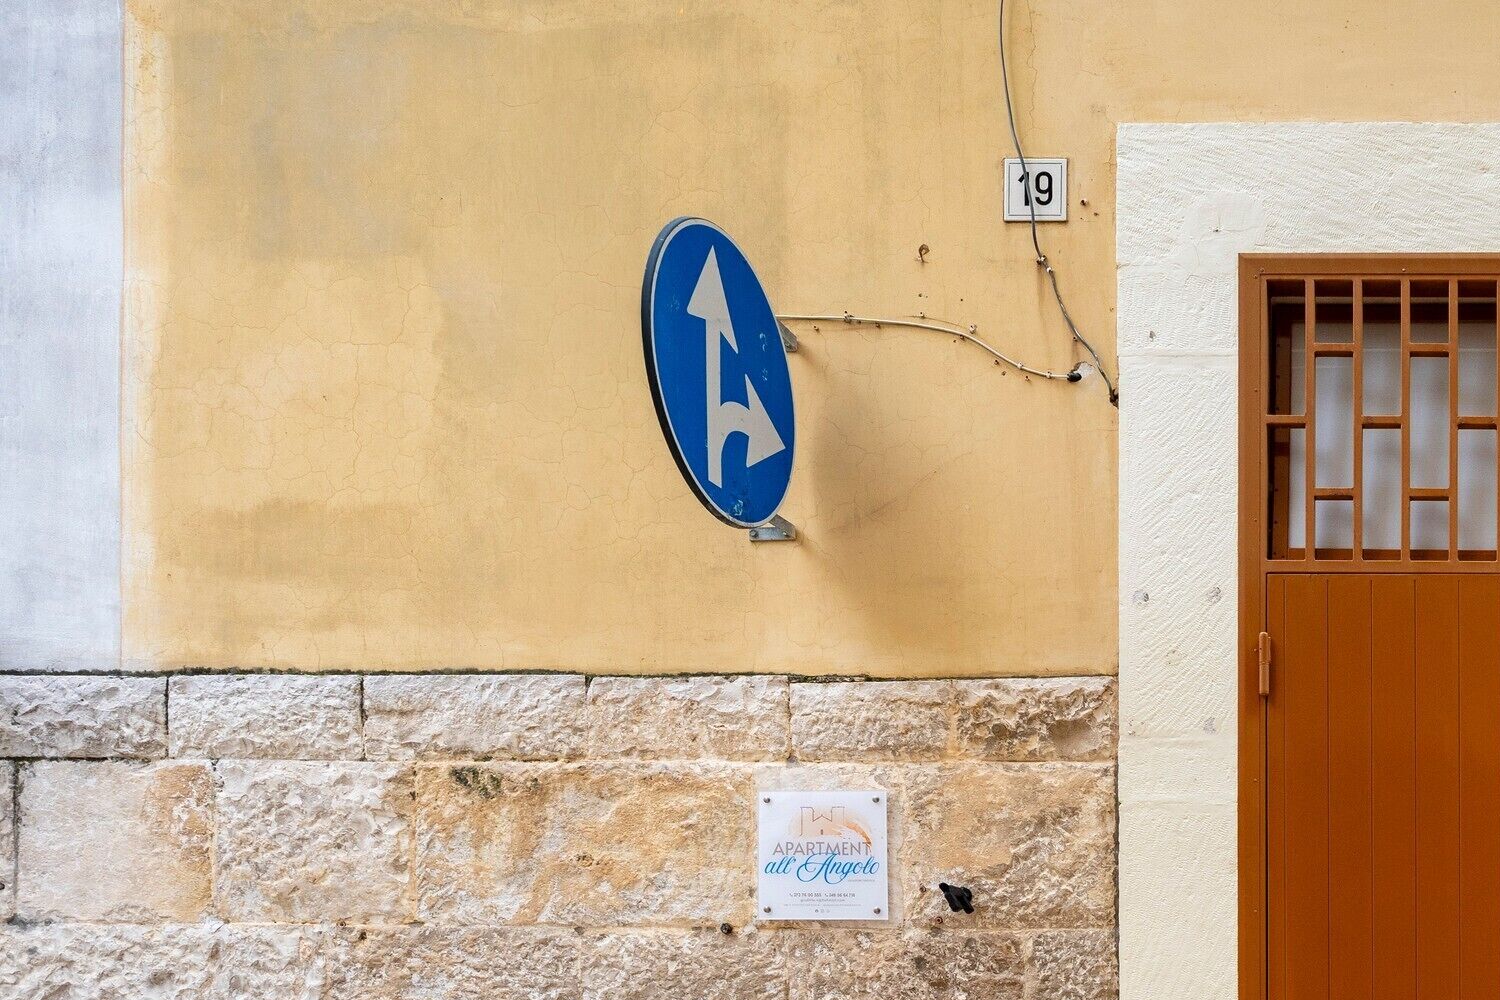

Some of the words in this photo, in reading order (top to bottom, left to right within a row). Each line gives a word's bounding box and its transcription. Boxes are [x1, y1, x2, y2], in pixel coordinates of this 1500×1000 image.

[1017, 171, 1053, 206] 19
[772, 841, 871, 856] APARTMENT
[797, 852, 880, 885] Angolo
